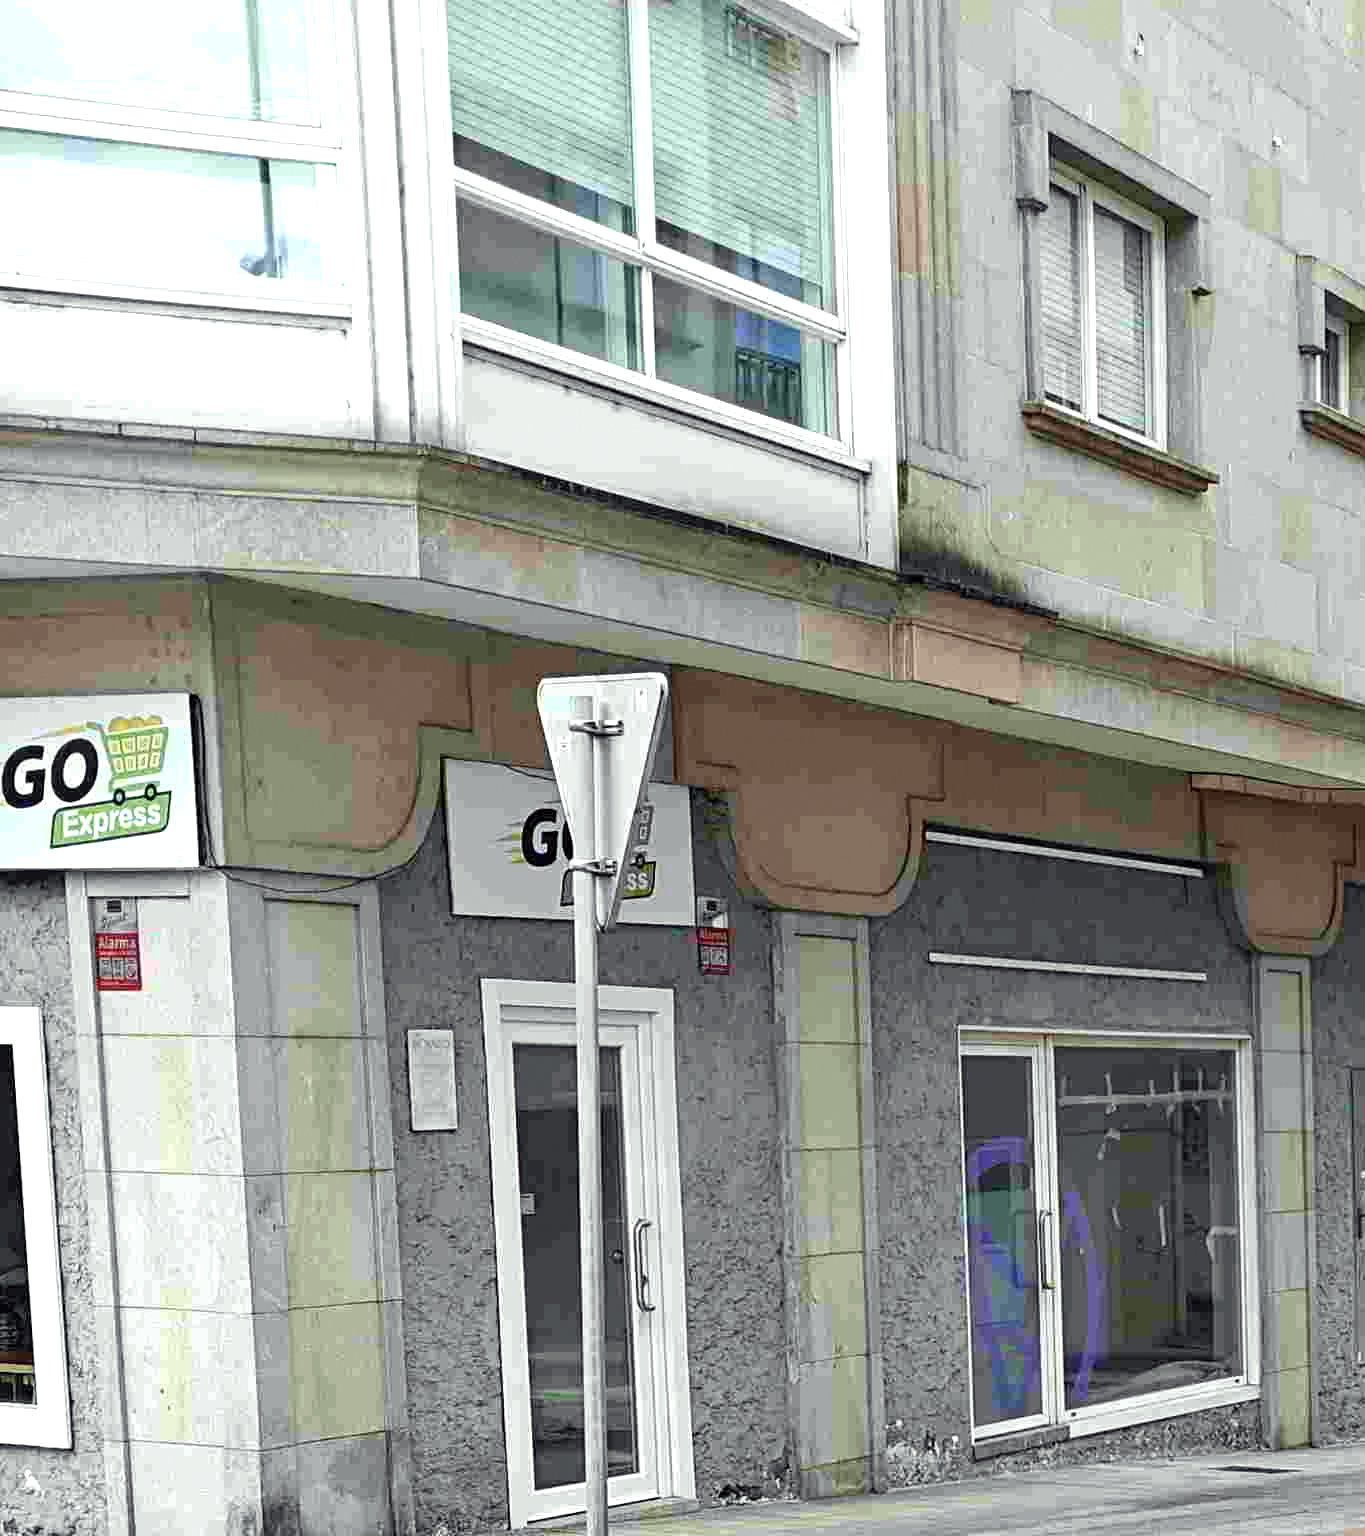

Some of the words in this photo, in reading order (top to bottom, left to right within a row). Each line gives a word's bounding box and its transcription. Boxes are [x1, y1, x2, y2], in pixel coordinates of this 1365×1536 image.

[2, 738, 99, 809] GO
[63, 803, 161, 839] Express
[522, 808, 574, 867] G
